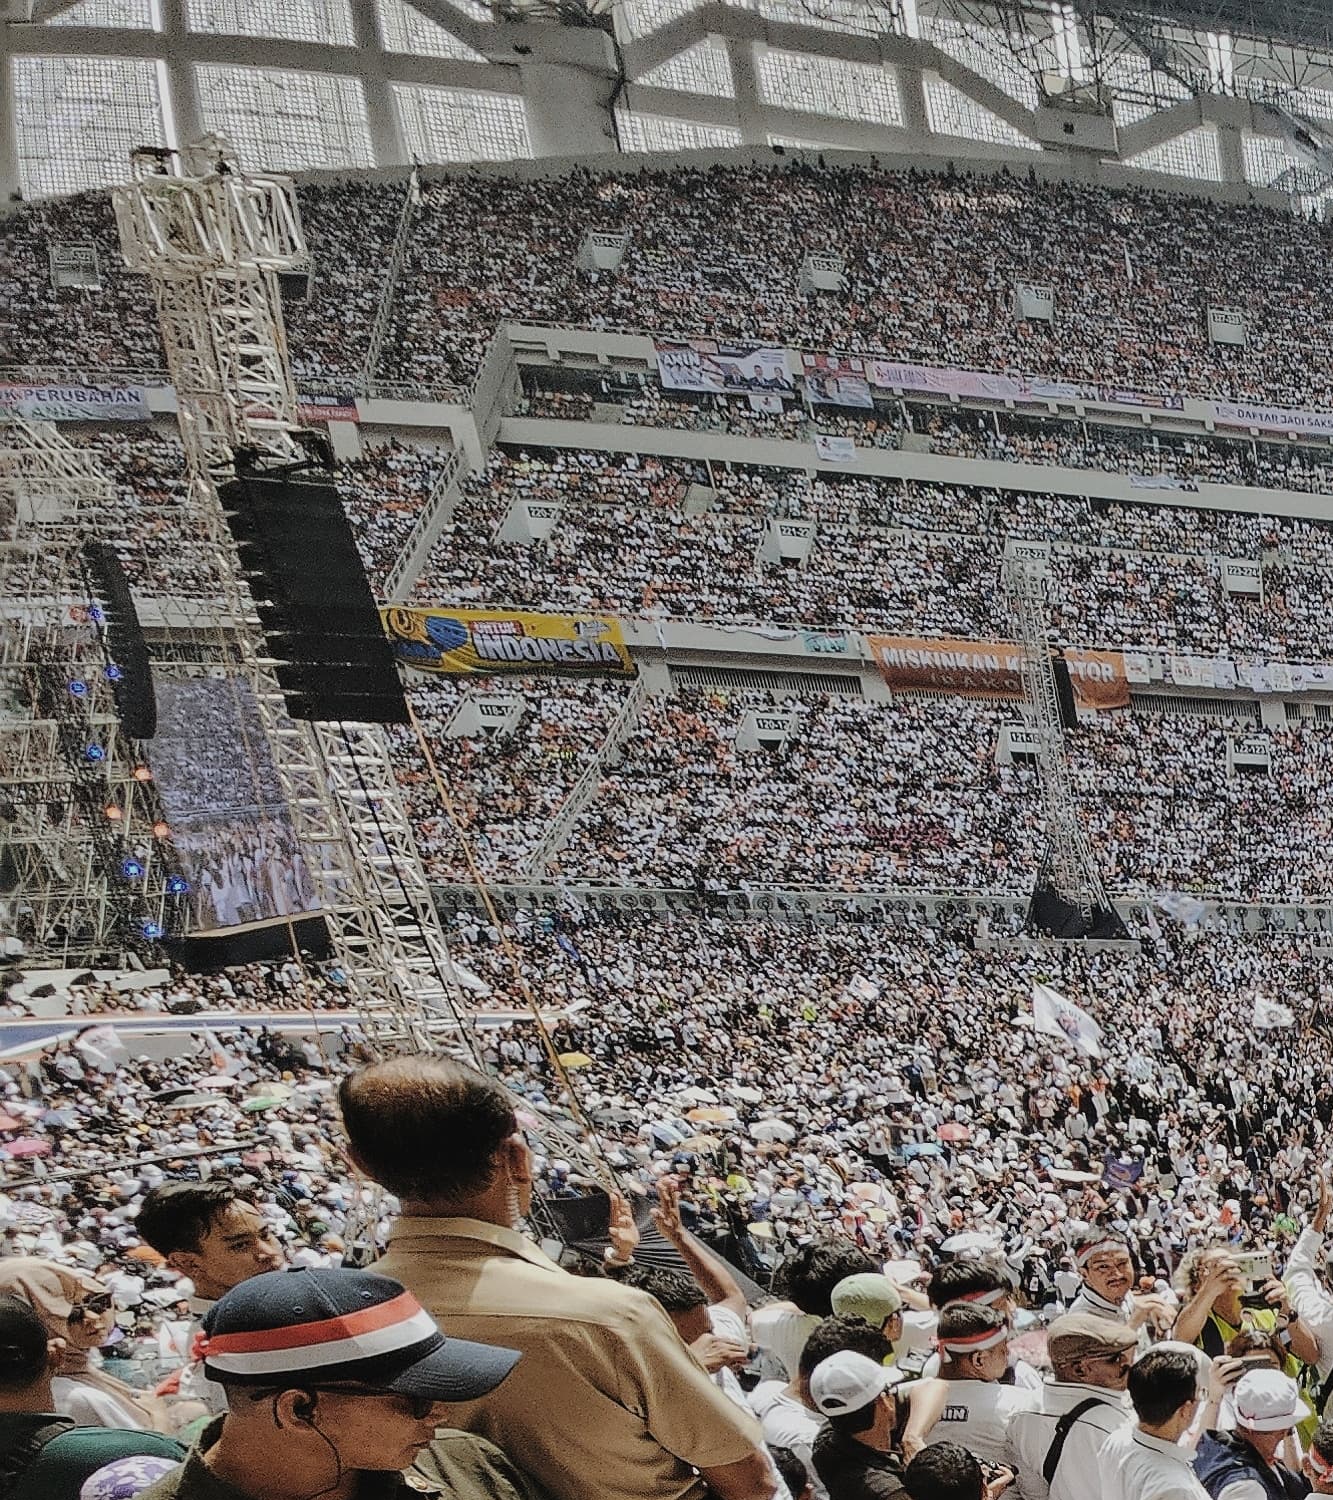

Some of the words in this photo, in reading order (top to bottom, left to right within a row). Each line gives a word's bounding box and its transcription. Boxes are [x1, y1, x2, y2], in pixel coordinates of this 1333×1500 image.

[24, 387, 141, 403] PERUBAHAN
[1237, 409, 1279, 425] DAFTAR
[1280, 415, 1306, 427] JADI
[472, 633, 623, 669] INDONESIA
